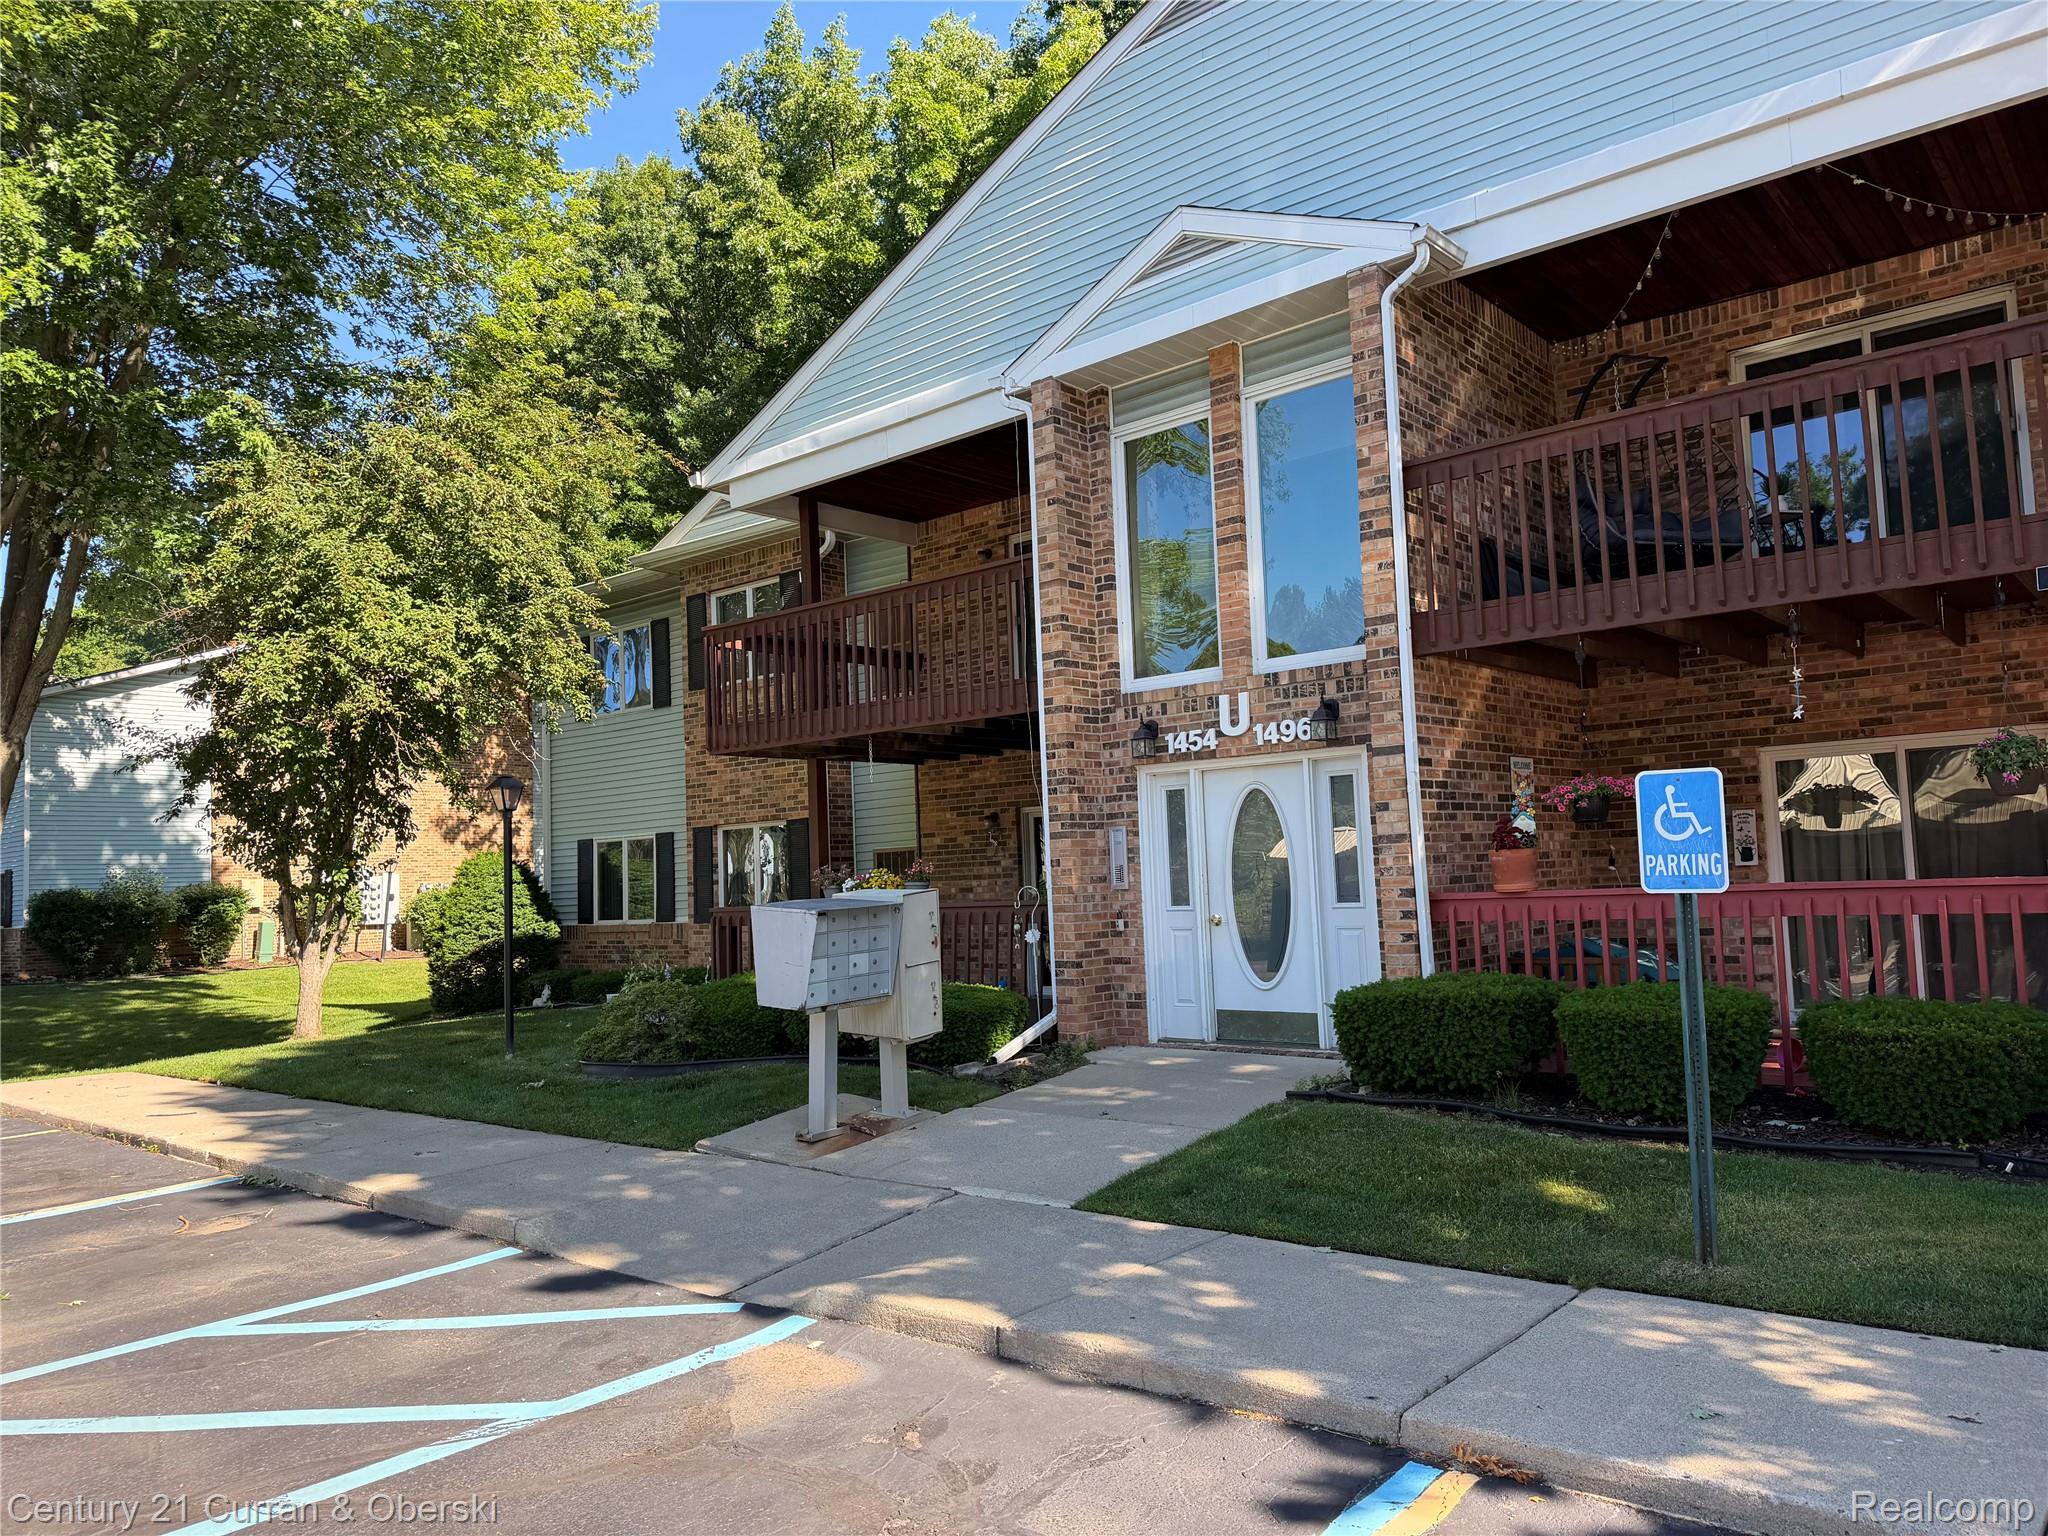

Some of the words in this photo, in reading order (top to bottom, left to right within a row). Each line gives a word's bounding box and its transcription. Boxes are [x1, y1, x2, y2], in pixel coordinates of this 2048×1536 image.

[1165, 728, 1218, 754] 1454
[1219, 692, 1250, 736] U
[1253, 717, 1311, 746] 1496
[1645, 852, 1722, 876] PARKING
